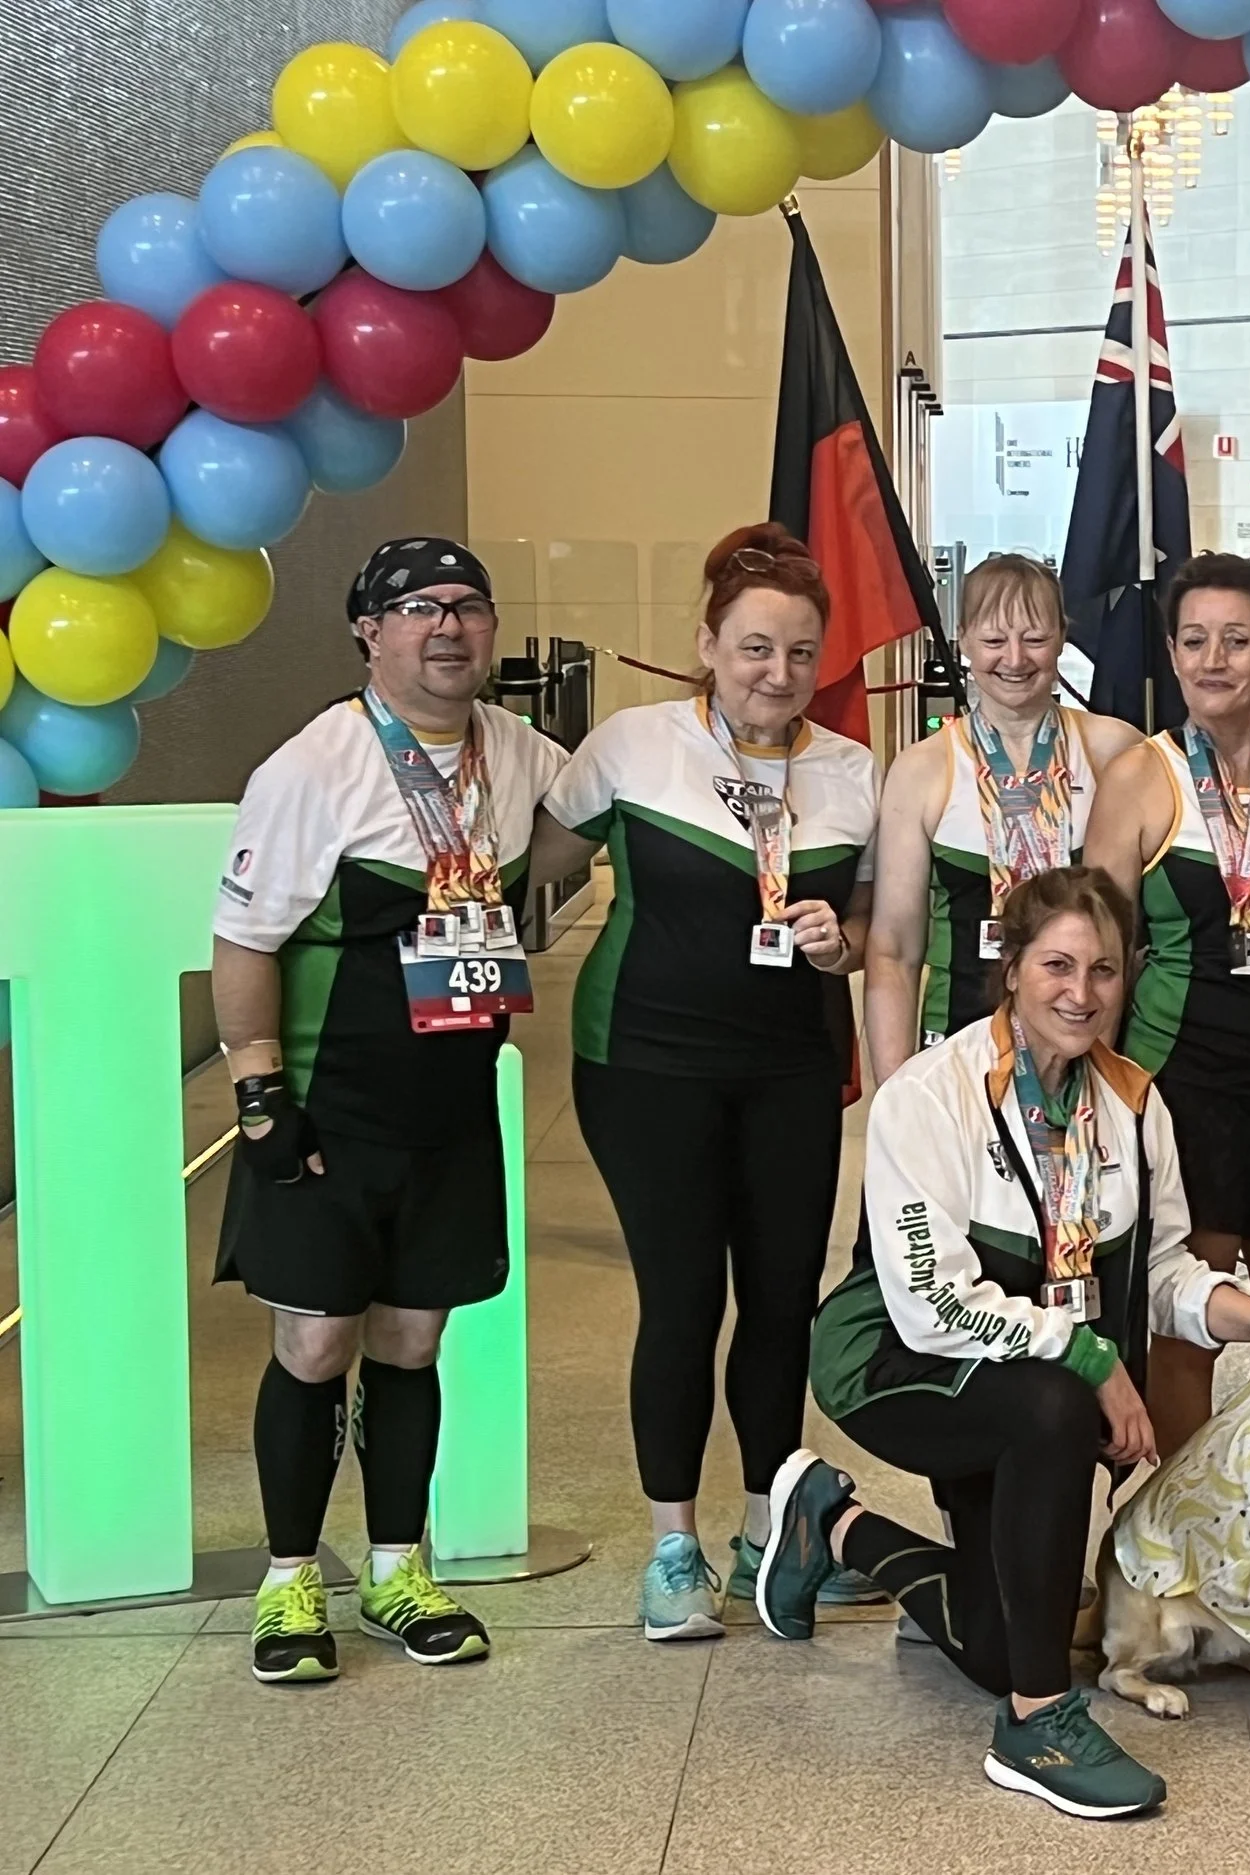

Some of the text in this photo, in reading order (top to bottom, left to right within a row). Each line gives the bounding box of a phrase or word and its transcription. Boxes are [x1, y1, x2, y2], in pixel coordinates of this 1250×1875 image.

[904, 350, 917, 366] A
[714, 777, 774, 797] STAIR
[448, 960, 502, 993] 439
[896, 1200, 939, 1294] Australia
